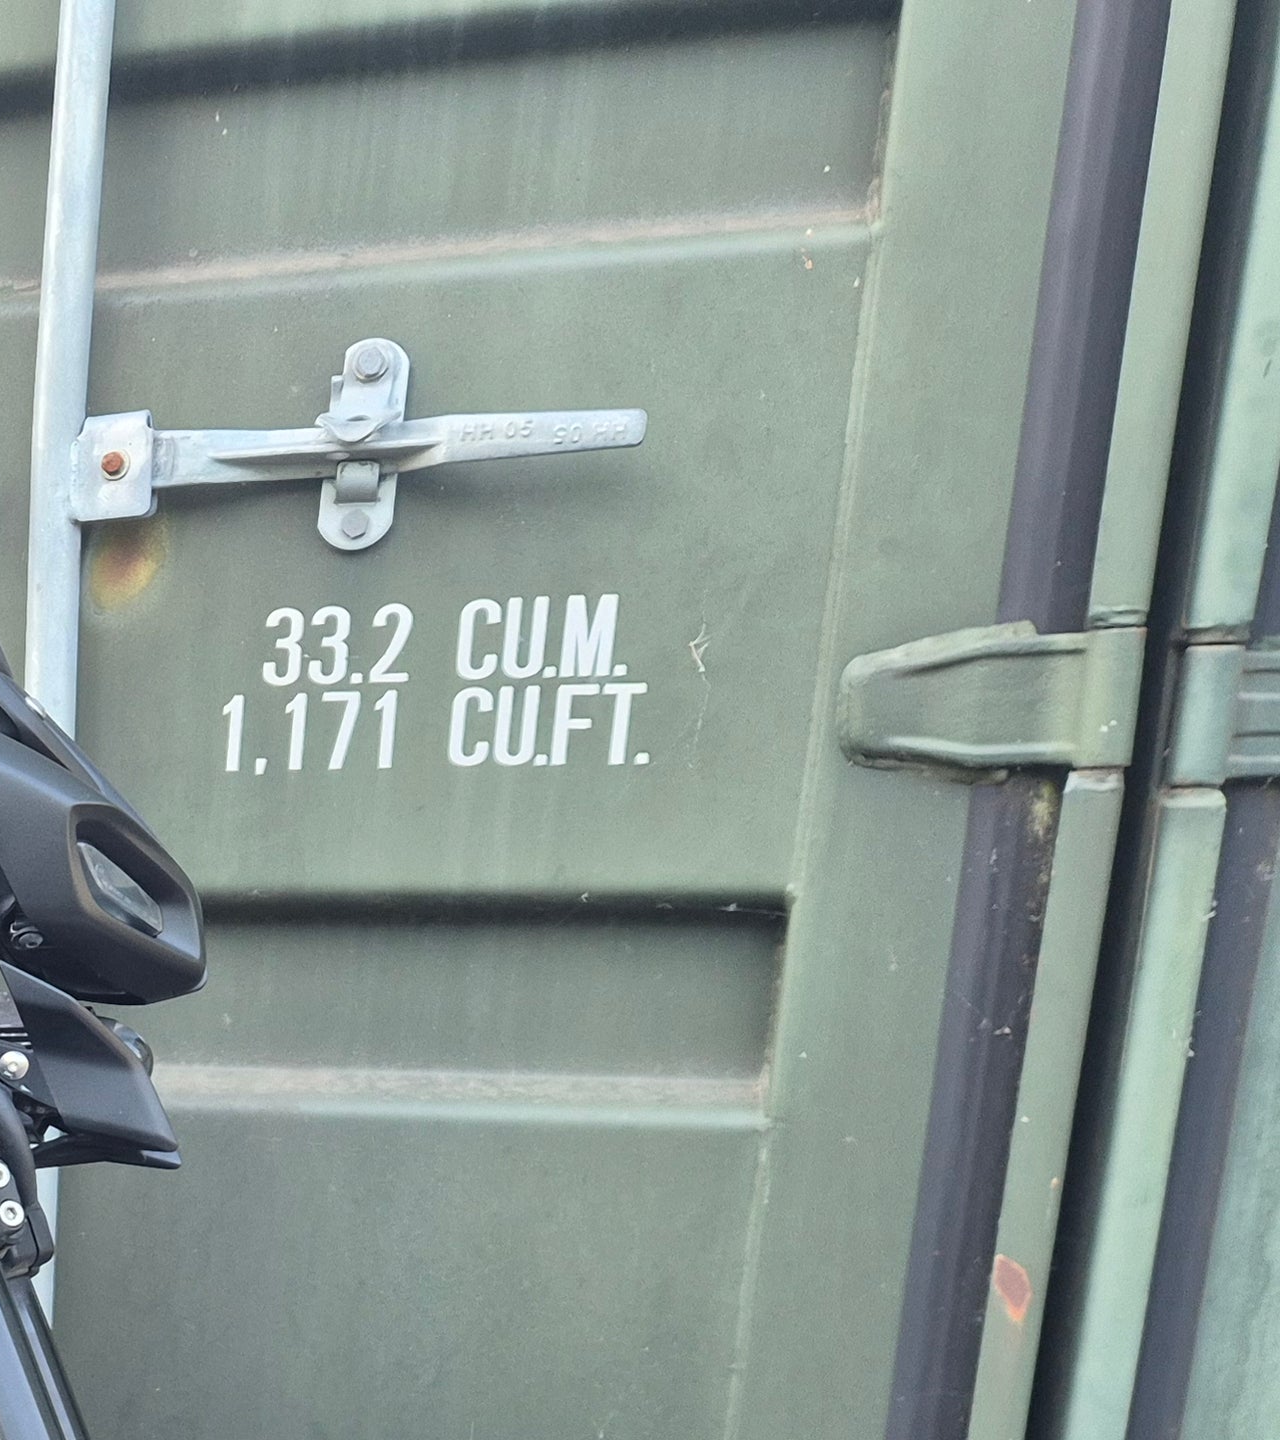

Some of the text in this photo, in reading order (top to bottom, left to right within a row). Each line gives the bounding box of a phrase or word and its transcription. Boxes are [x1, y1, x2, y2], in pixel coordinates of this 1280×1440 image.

[262, 594, 628, 687] 33.2 CU.M.
[222, 682, 651, 776] 1,171 CU.FT.
